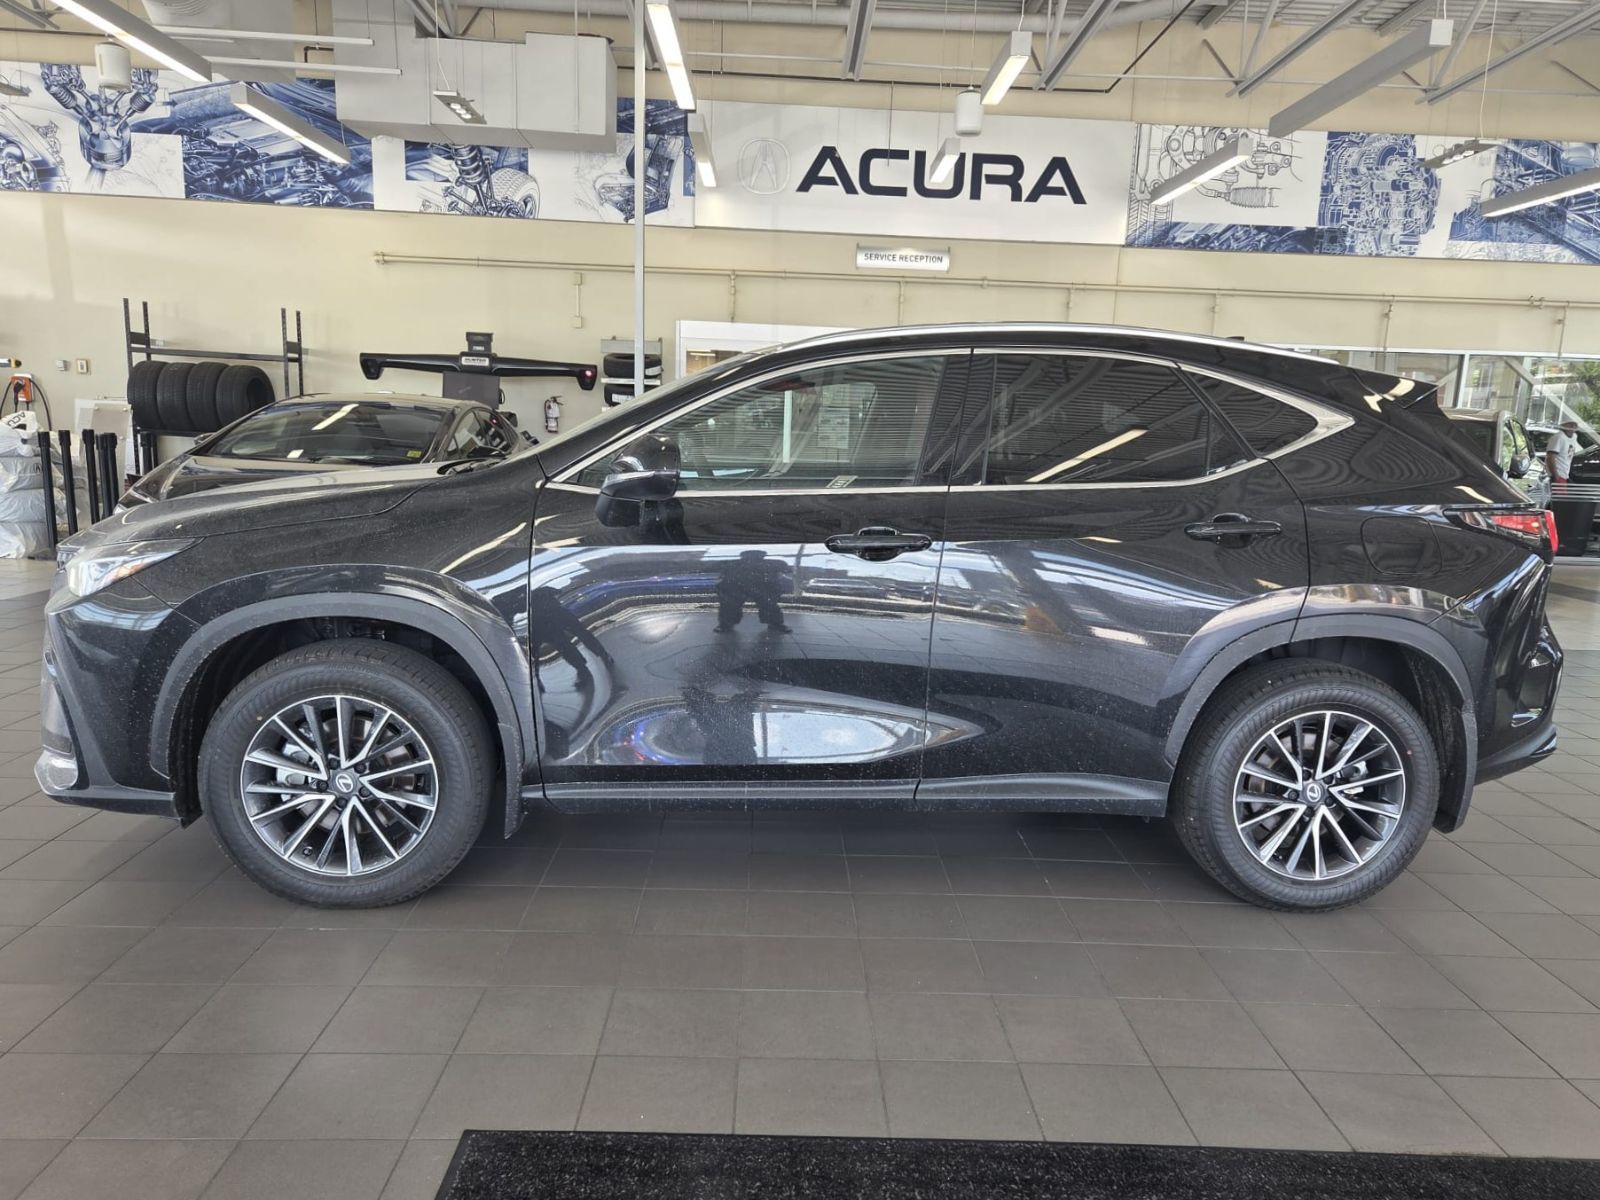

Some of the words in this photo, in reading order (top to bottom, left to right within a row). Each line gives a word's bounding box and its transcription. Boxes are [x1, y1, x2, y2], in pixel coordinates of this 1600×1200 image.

[795, 145, 1087, 205] ACURA
[864, 252, 897, 262] SERVICE
[898, 254, 944, 264] RECEPTION
